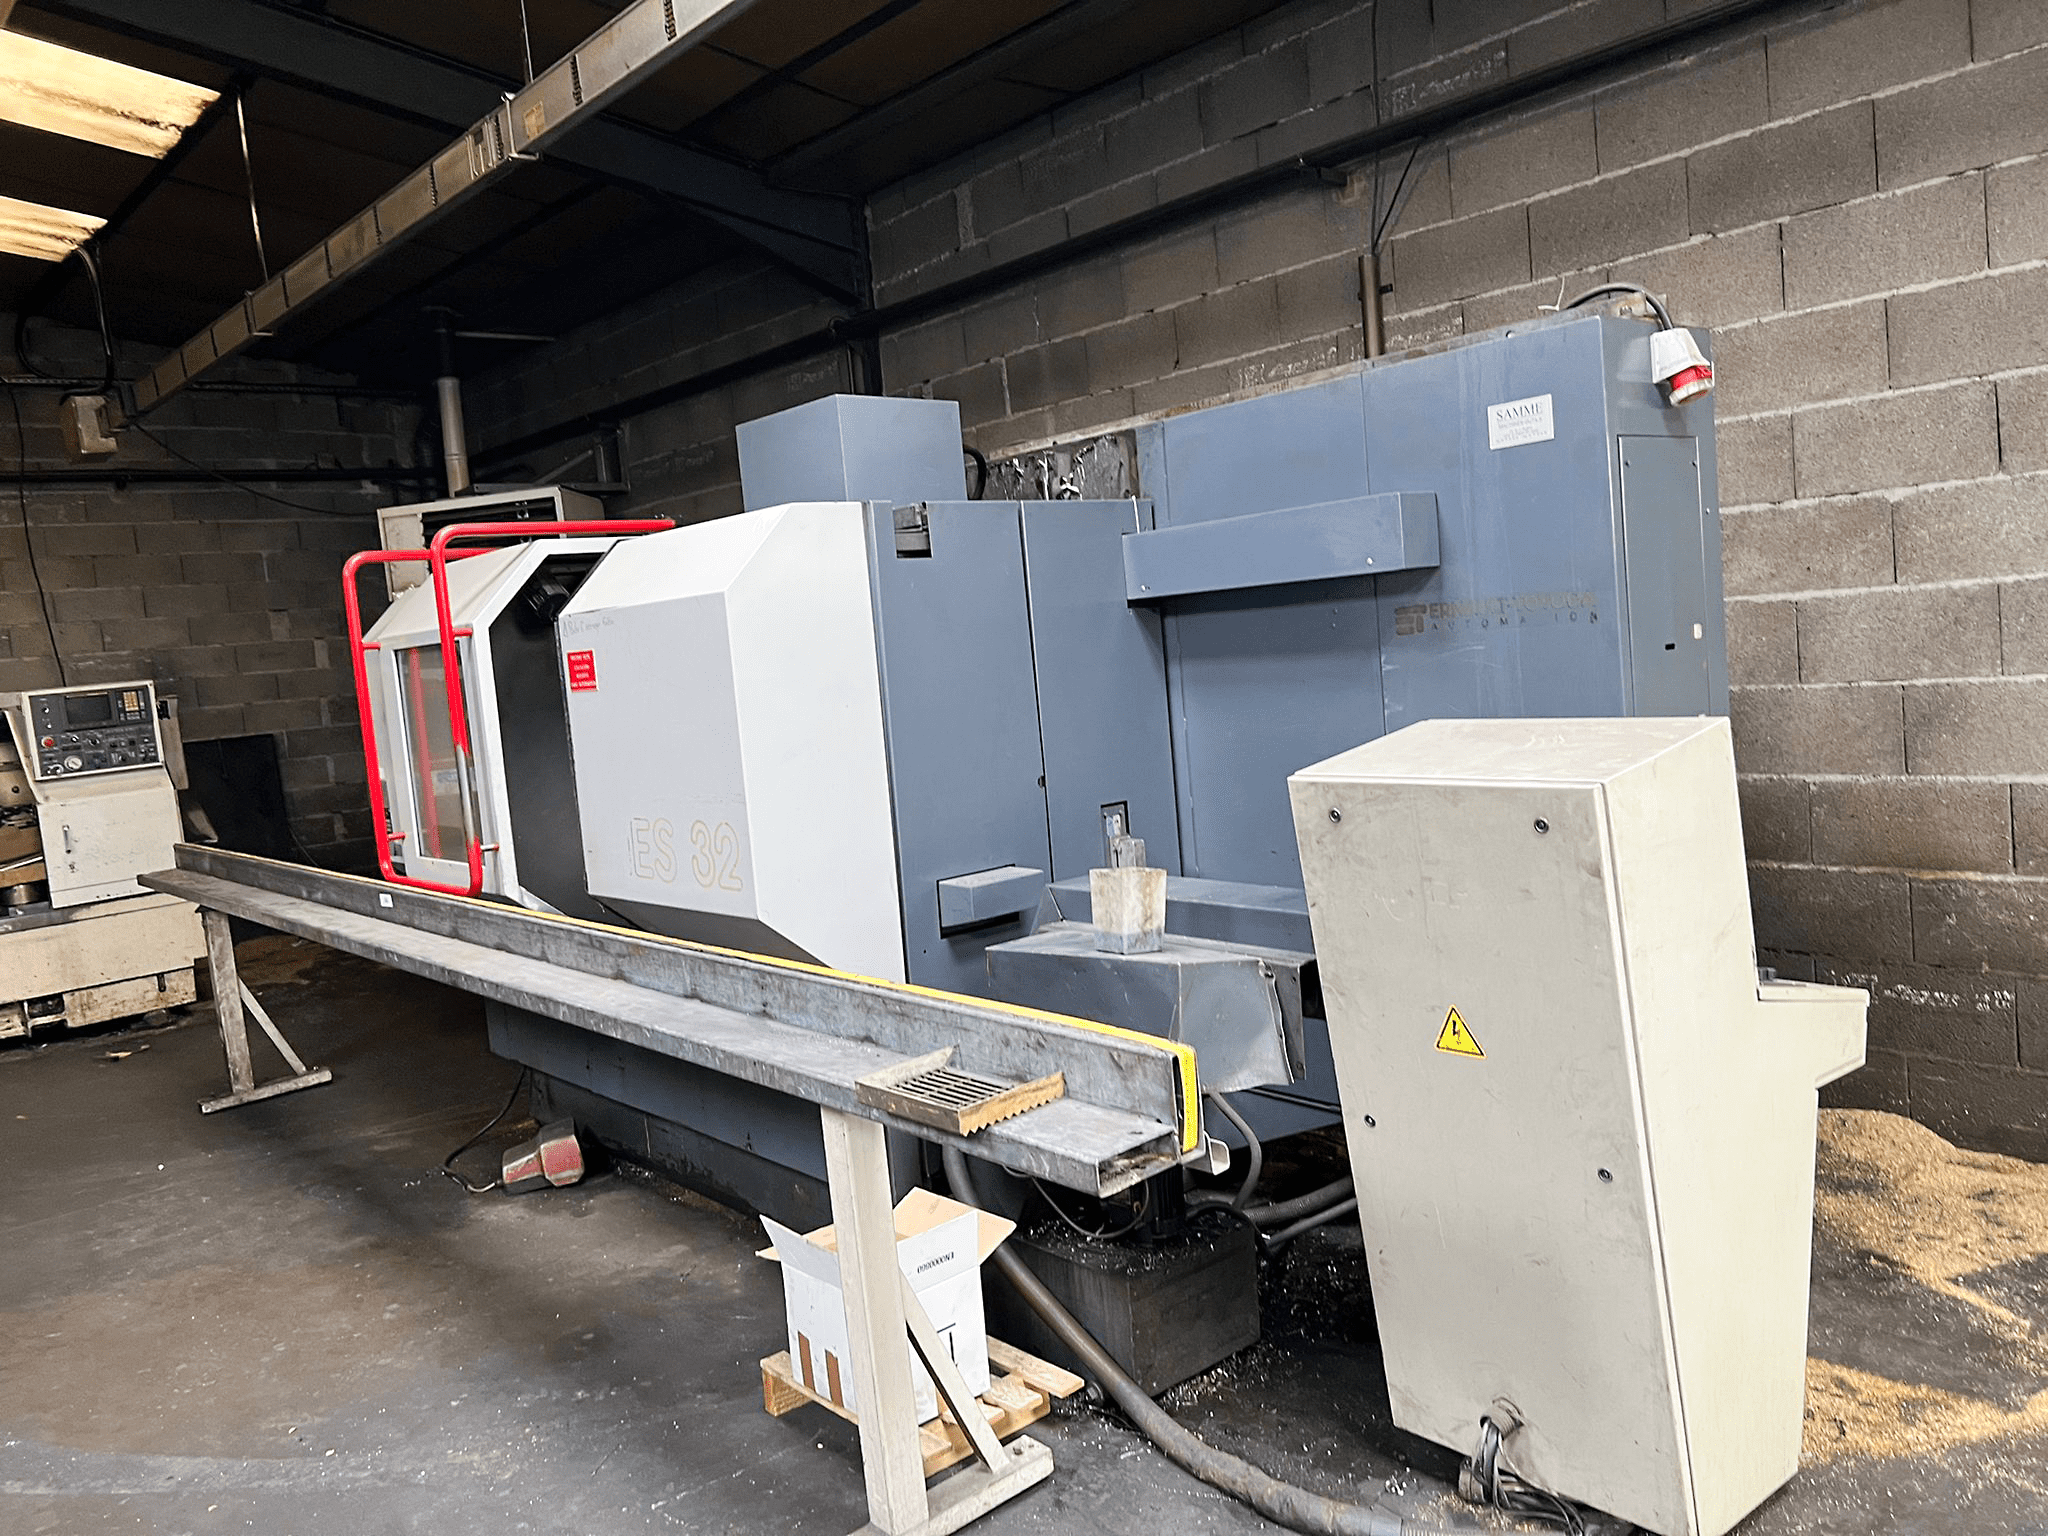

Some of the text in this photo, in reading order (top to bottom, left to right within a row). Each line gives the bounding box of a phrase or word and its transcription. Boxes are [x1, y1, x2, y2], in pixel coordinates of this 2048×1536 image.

[1496, 403, 1544, 421] SAMME
[1431, 610, 1598, 631] AUTOMAION
[628, 817, 744, 892] ES 32
